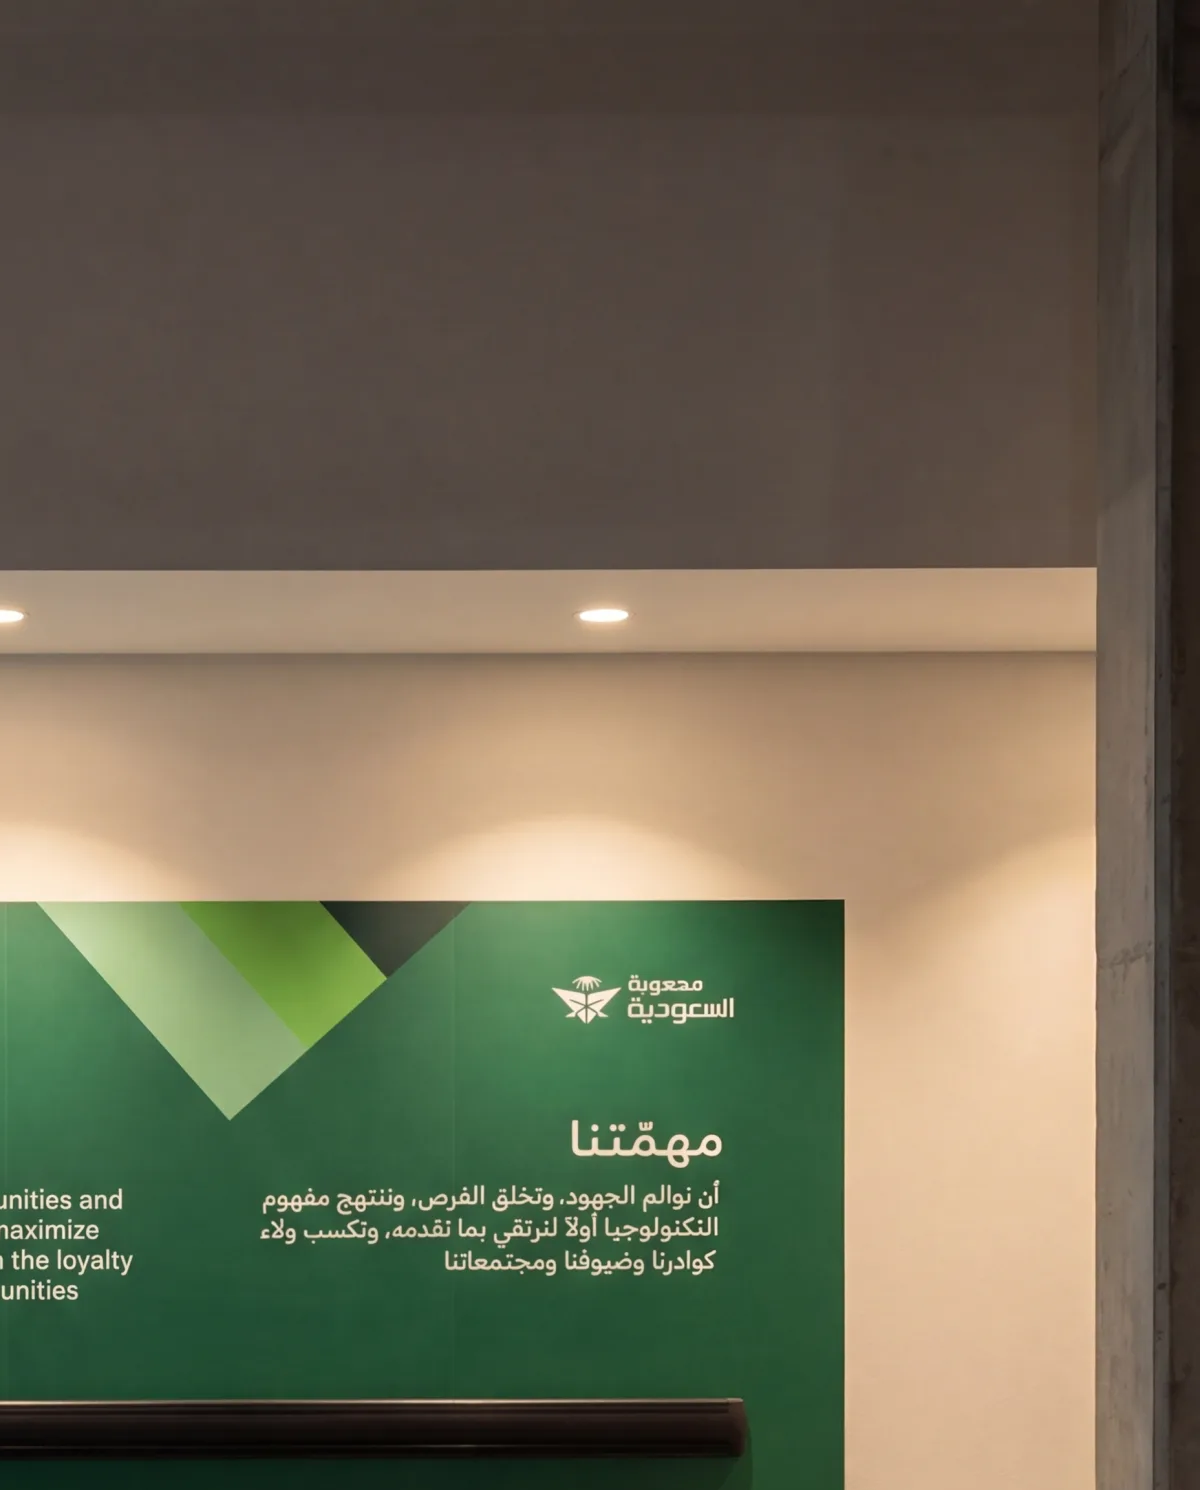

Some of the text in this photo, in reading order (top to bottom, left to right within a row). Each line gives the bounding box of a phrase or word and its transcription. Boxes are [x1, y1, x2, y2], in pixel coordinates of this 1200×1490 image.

[627, 996, 735, 1025] السعودية
[79, 1187, 123, 1210] and
[262, 1187, 330, 1215] مفهوم
[411, 1184, 485, 1212] الفرص،
[559, 1184, 635, 1211] الجهود،
[698, 1179, 720, 1210] أن
[259, 1218, 297, 1245] ولاء
[458, 1217, 487, 1243] بما
[493, 1216, 558, 1249] لنرتقي
[10, 1248, 50, 1271] the
[57, 1248, 134, 1276] loyalty
[444, 1248, 717, 1277] كوادرنا وضيوفنا ومجتمعاتنا
